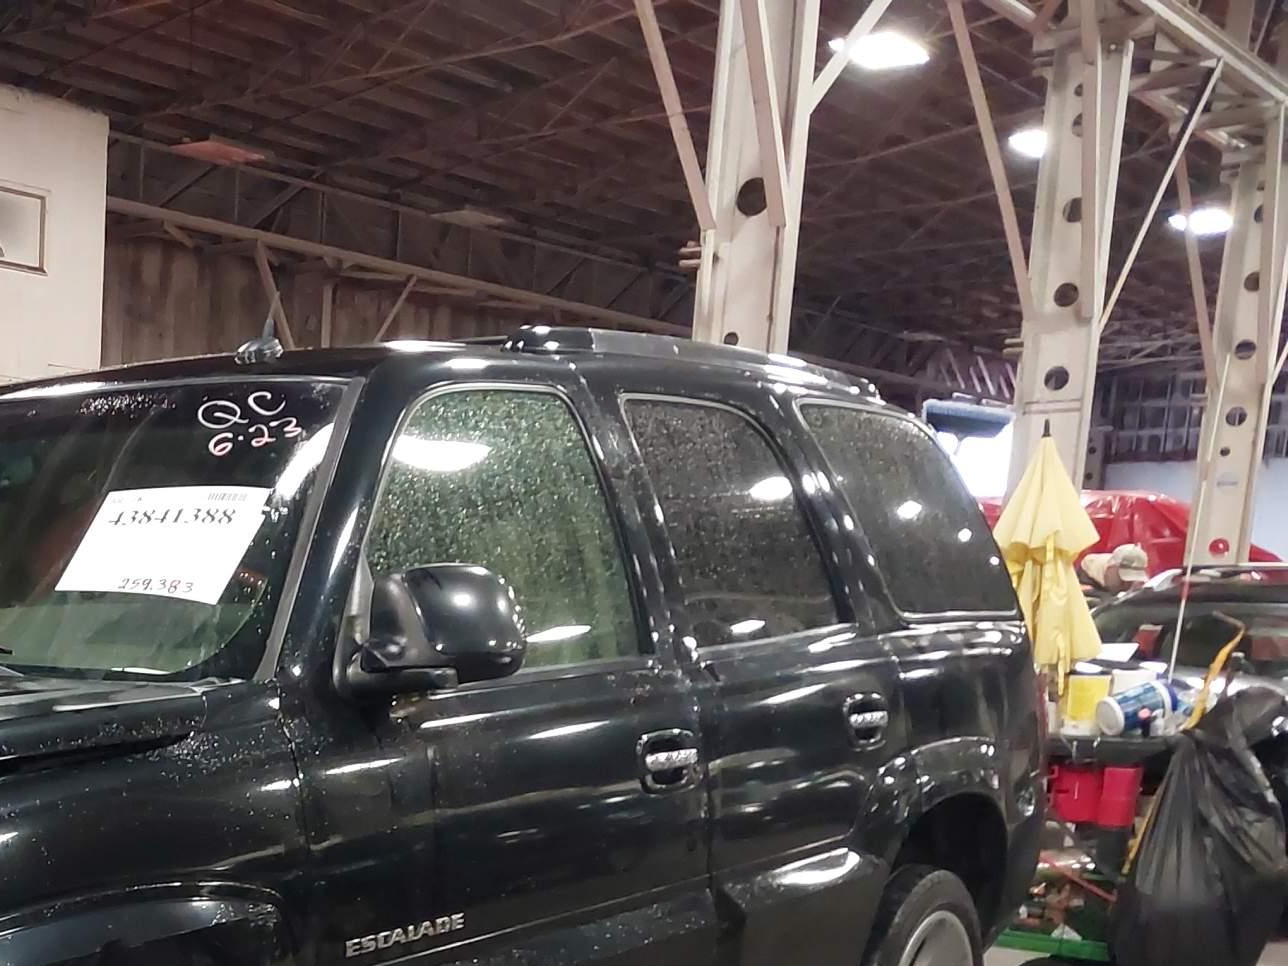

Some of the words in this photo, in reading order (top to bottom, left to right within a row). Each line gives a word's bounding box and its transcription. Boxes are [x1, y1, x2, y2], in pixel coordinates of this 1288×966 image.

[197, 391, 286, 429] QC
[108, 508, 236, 526] 43841388
[345, 912, 465, 958] ESCALADE
